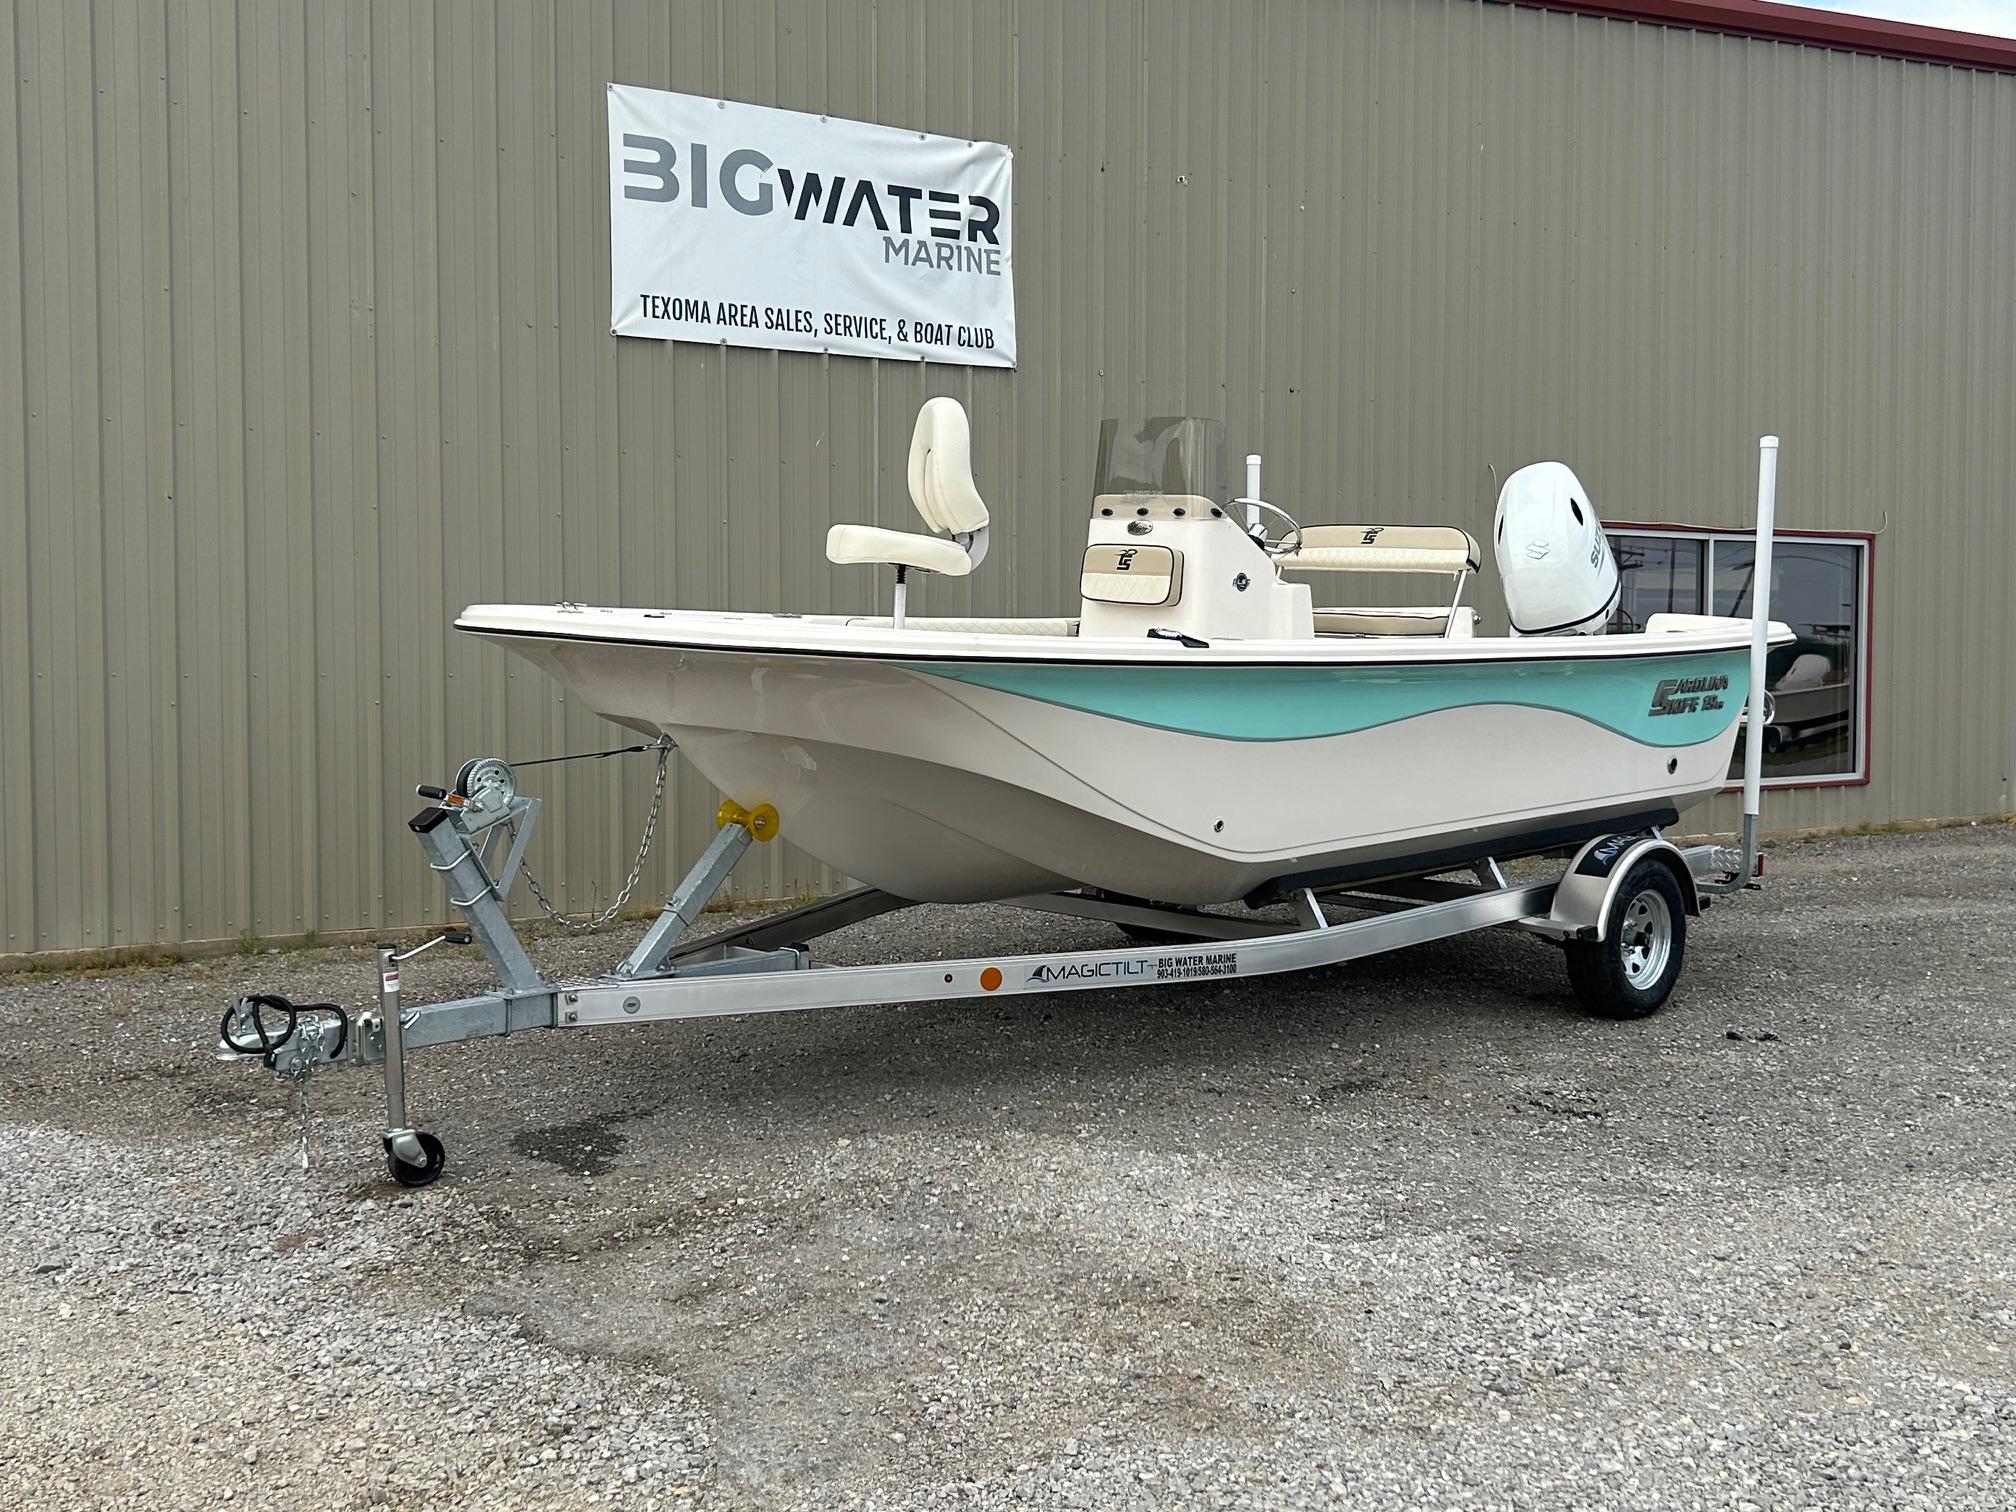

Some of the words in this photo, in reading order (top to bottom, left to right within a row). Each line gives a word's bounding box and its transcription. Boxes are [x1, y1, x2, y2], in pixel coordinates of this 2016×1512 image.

[883, 236, 1001, 275] MARINE
[640, 294, 711, 324] TEXOMA
[716, 302, 759, 328] AREA
[764, 307, 818, 338] SALES,
[824, 313, 892, 345] SERVICE,
[897, 319, 909, 342] &
[914, 322, 953, 346] BOAT
[957, 326, 995, 349] CLUB
[1046, 960, 1148, 980] MAGICTILT
[1158, 957, 1173, 968] BIG
[1175, 955, 1204, 967] WATER
[1206, 953, 1237, 965] MARINE
